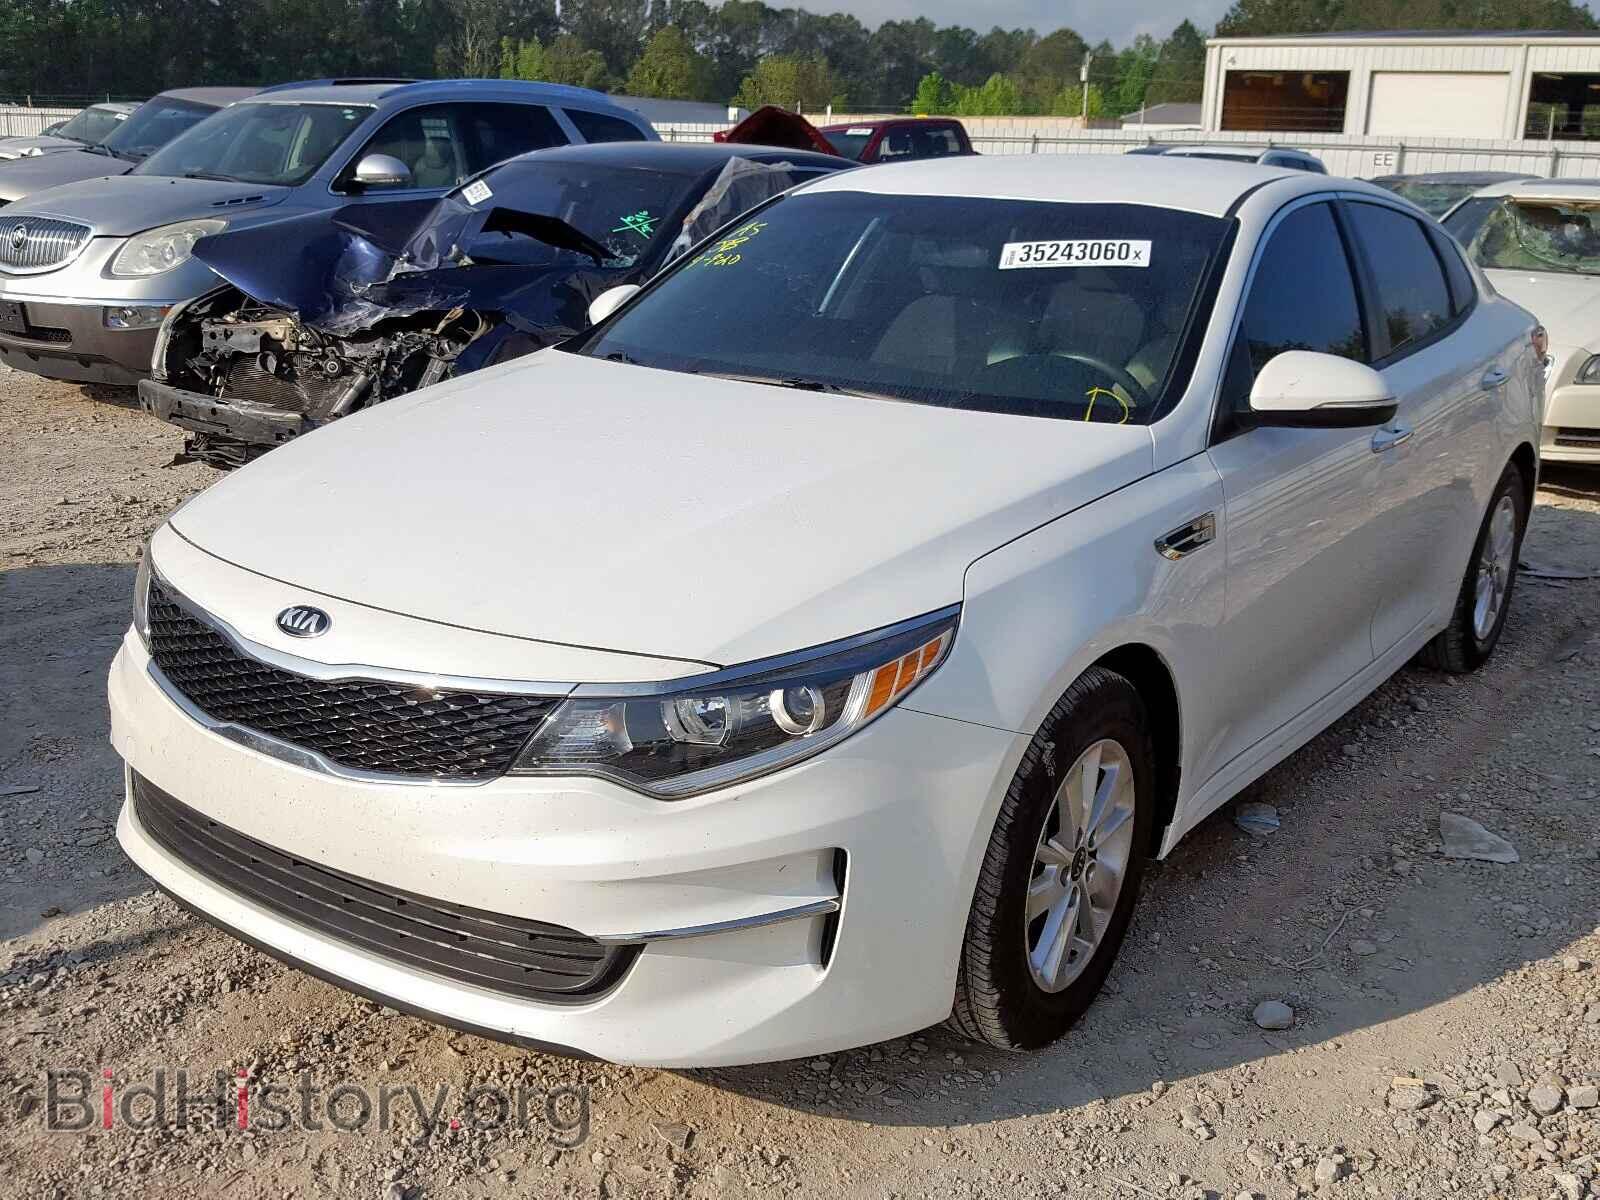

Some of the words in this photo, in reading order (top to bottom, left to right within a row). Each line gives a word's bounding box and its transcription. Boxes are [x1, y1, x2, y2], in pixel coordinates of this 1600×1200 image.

[1374, 153, 1393, 167] EE
[1019, 242, 1131, 263] 35243060
[280, 607, 321, 633] KIA
